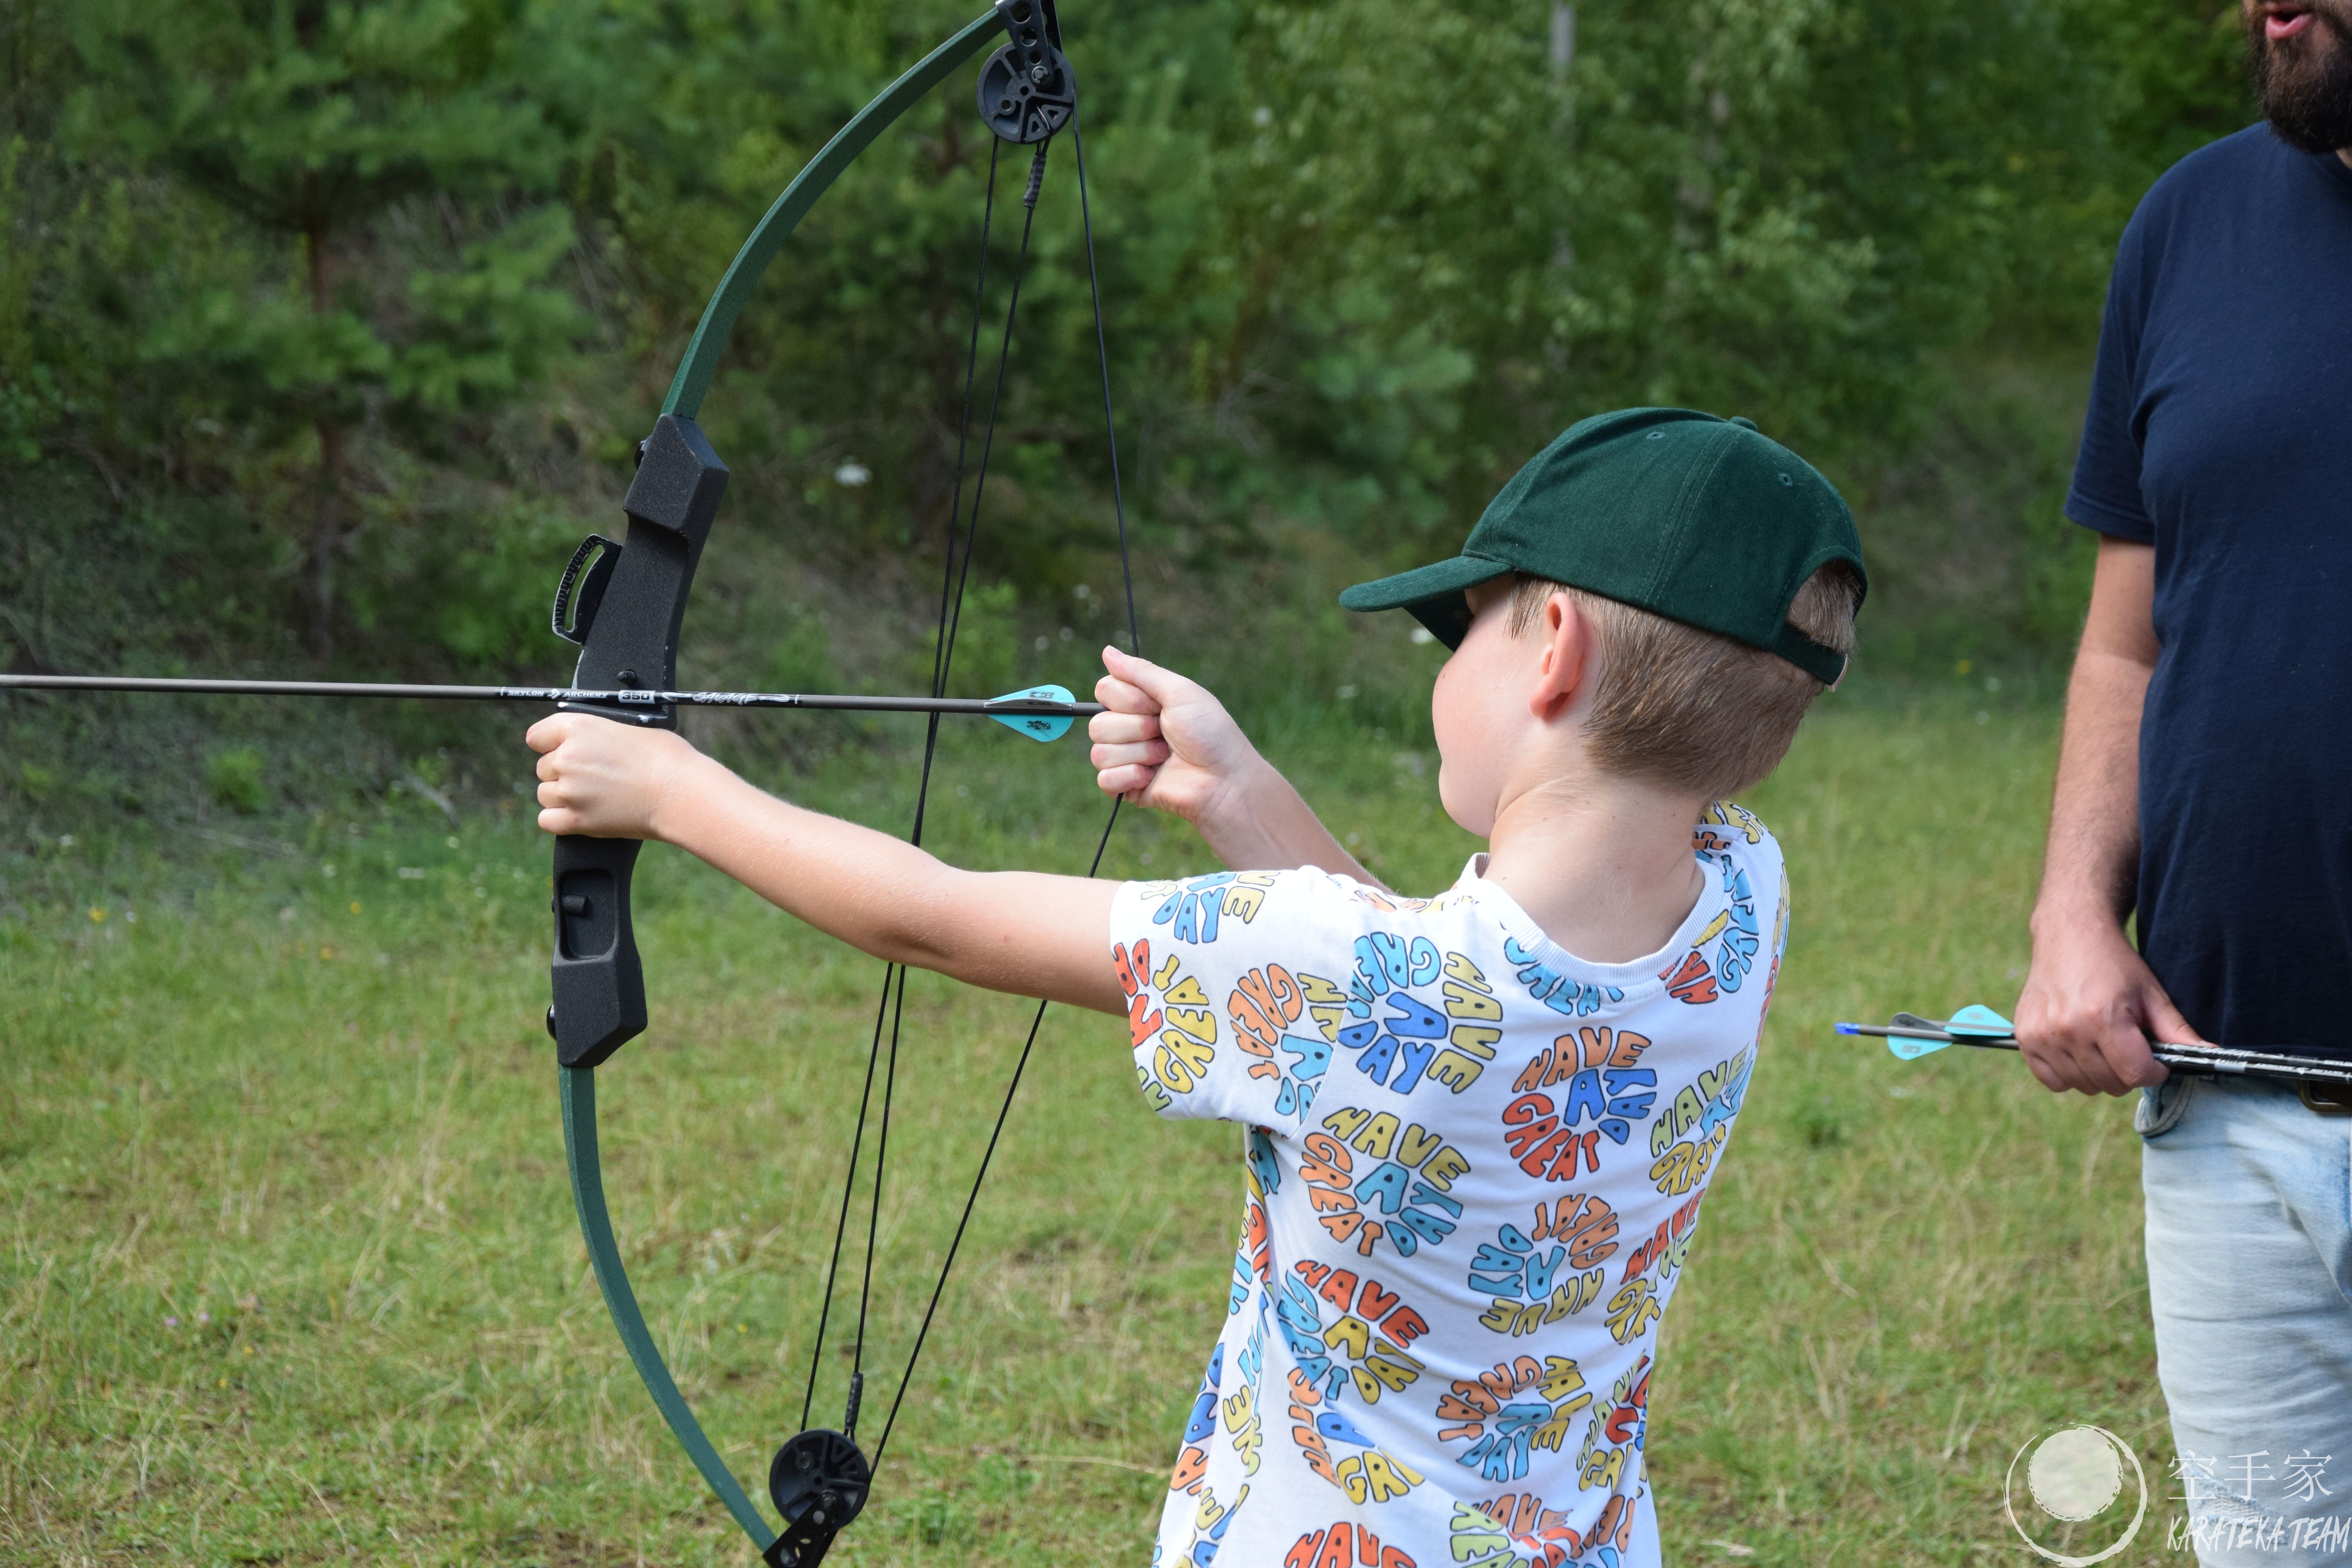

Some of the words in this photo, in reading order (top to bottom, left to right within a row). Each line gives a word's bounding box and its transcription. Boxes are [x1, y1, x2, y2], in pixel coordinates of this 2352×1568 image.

[622, 692, 650, 700] 350
[692, 692, 757, 705] SAVAGE
[1152, 887, 1226, 945] DAY
[1153, 954, 1218, 1093] GREAT
[1227, 963, 1303, 1080] GREAT
[1384, 991, 1449, 1040] A
[1426, 951, 1503, 1094] HAVE
[1281, 1033, 1334, 1082] A
[1337, 1020, 1436, 1095] DAY
[1512, 1026, 1652, 1093] HAVE
[1563, 1068, 1607, 1127] A
[1598, 1068, 1657, 1145] DAY
[1322, 1106, 1471, 1192] HAVE
[1502, 1093, 1601, 1182] GREAT
[1298, 1132, 1383, 1257] GREAT
[1354, 1161, 1410, 1215] A
[1385, 1181, 1464, 1258] DAY
[1468, 1223, 1534, 1298] DAY
[1532, 1193, 1619, 1269] GREAT
[1294, 1259, 1430, 1349] HAVE
[1479, 1268, 1604, 1337] HAVE
[1525, 1245, 1566, 1301] A
[1323, 1316, 1370, 1360] A
[1436, 1355, 1543, 1441] GREAT
[1495, 1403, 1552, 1435] A
[1455, 1425, 1537, 1483] DAY
